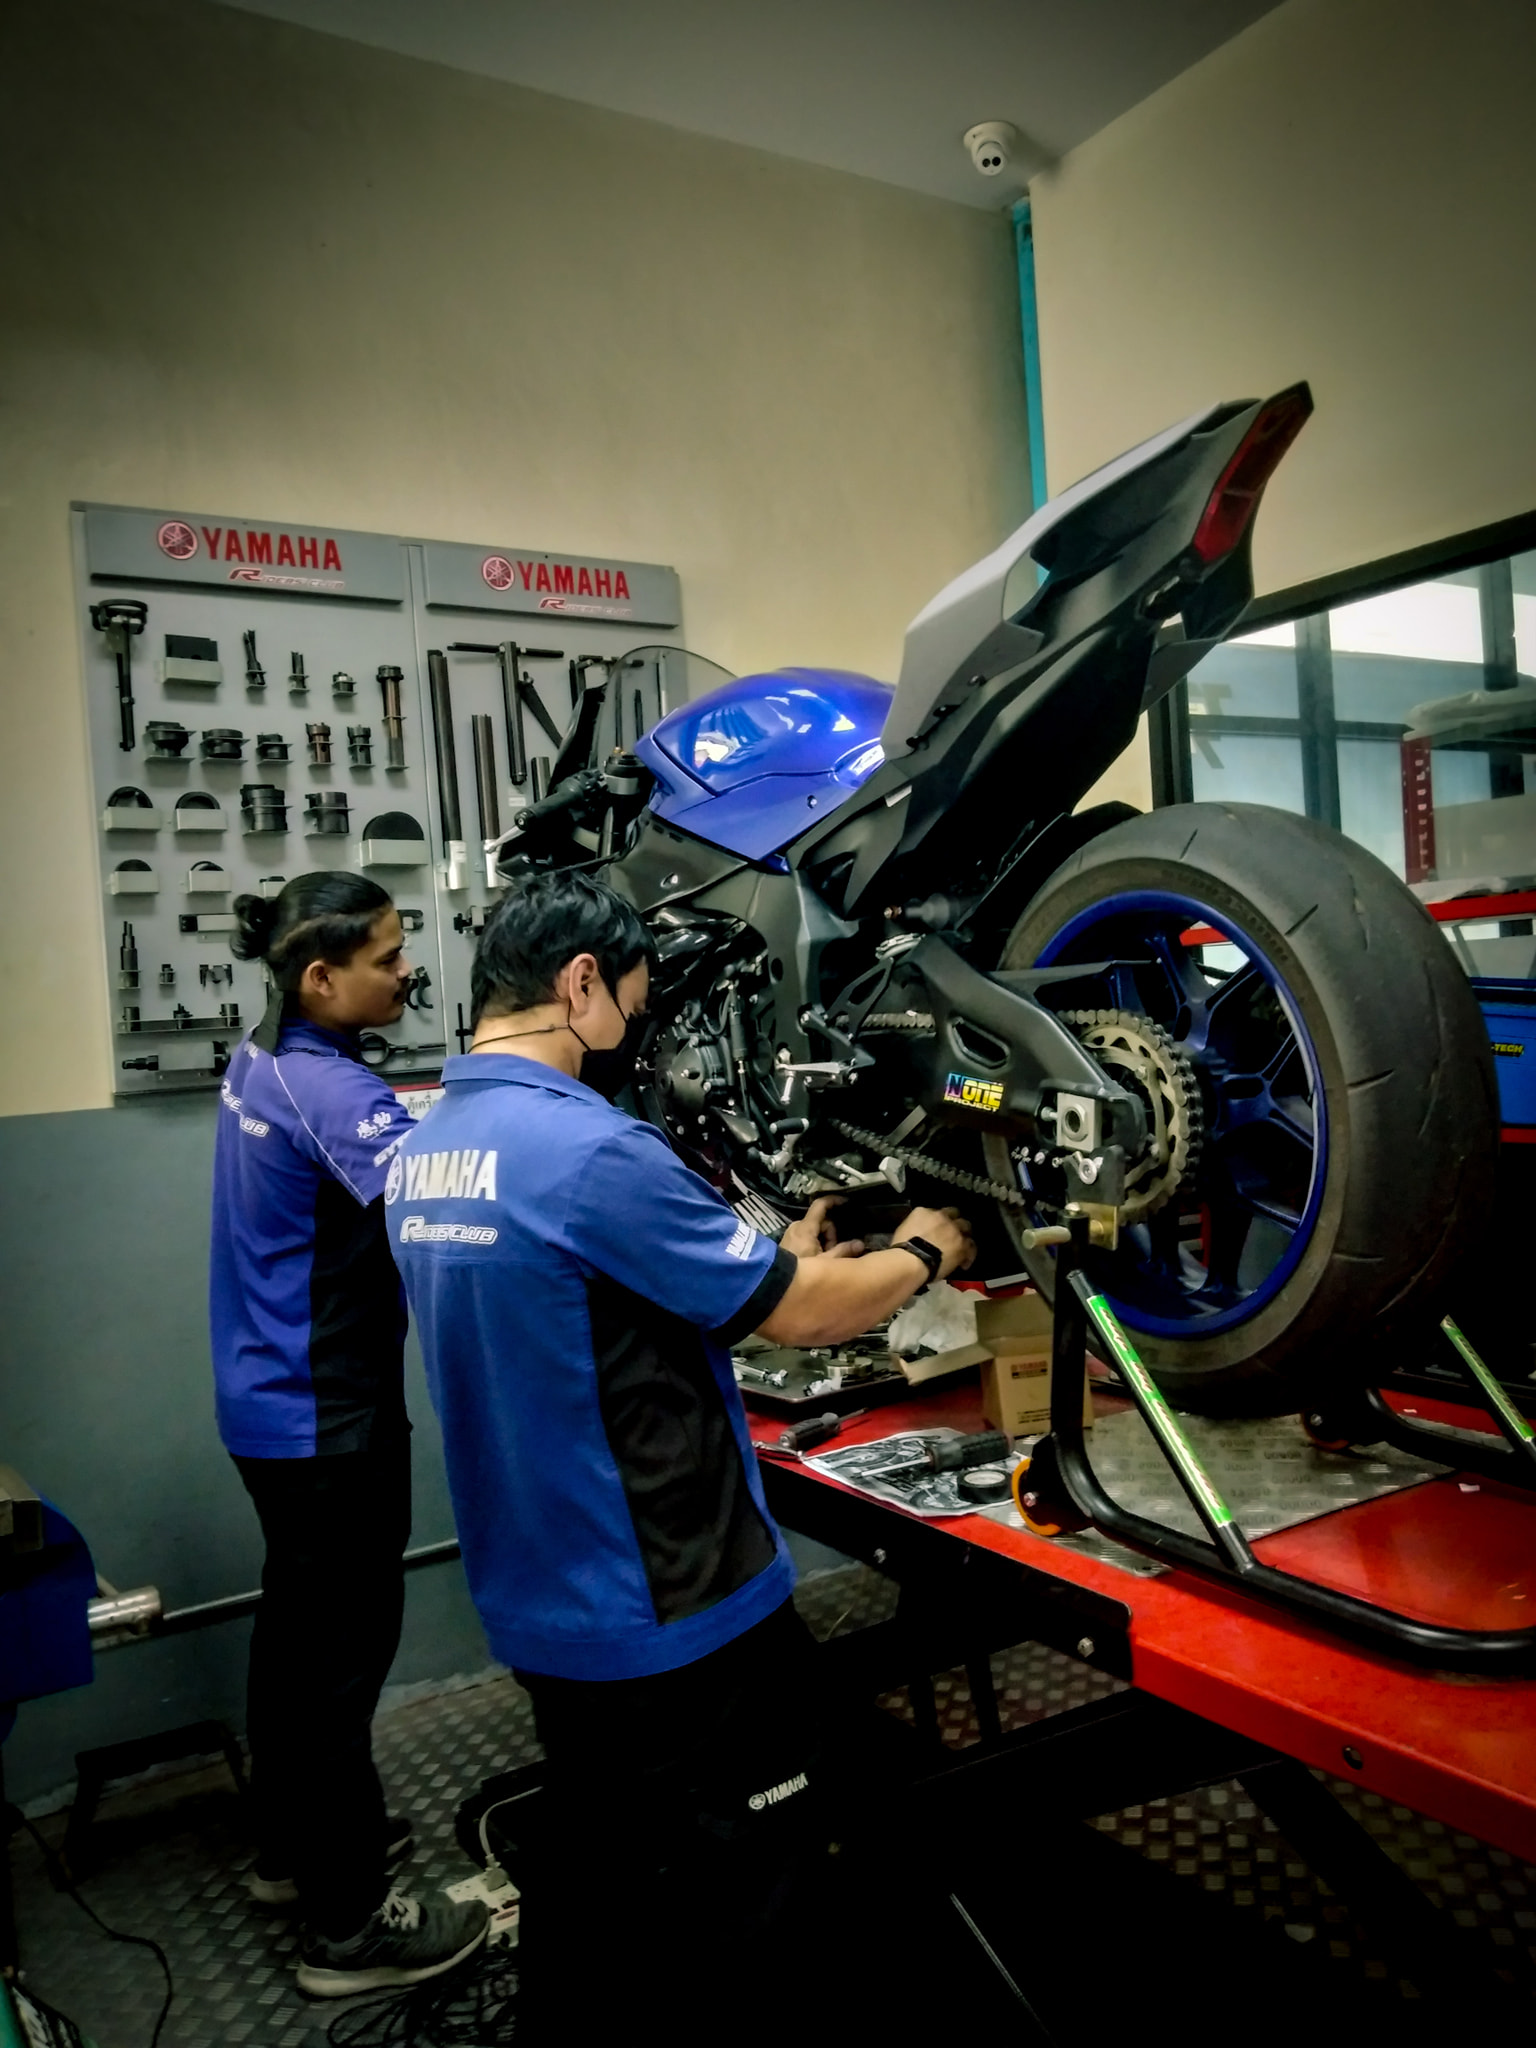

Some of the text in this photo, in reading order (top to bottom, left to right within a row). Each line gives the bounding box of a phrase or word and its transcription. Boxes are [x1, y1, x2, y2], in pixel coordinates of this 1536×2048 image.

[201, 526, 342, 571] YAMAHA
[516, 560, 630, 600] YAMAHA
[404, 1149, 498, 1201] YAMAHA
[449, 1224, 499, 1245] CLUB
[764, 1772, 809, 1805] YAMAHA
